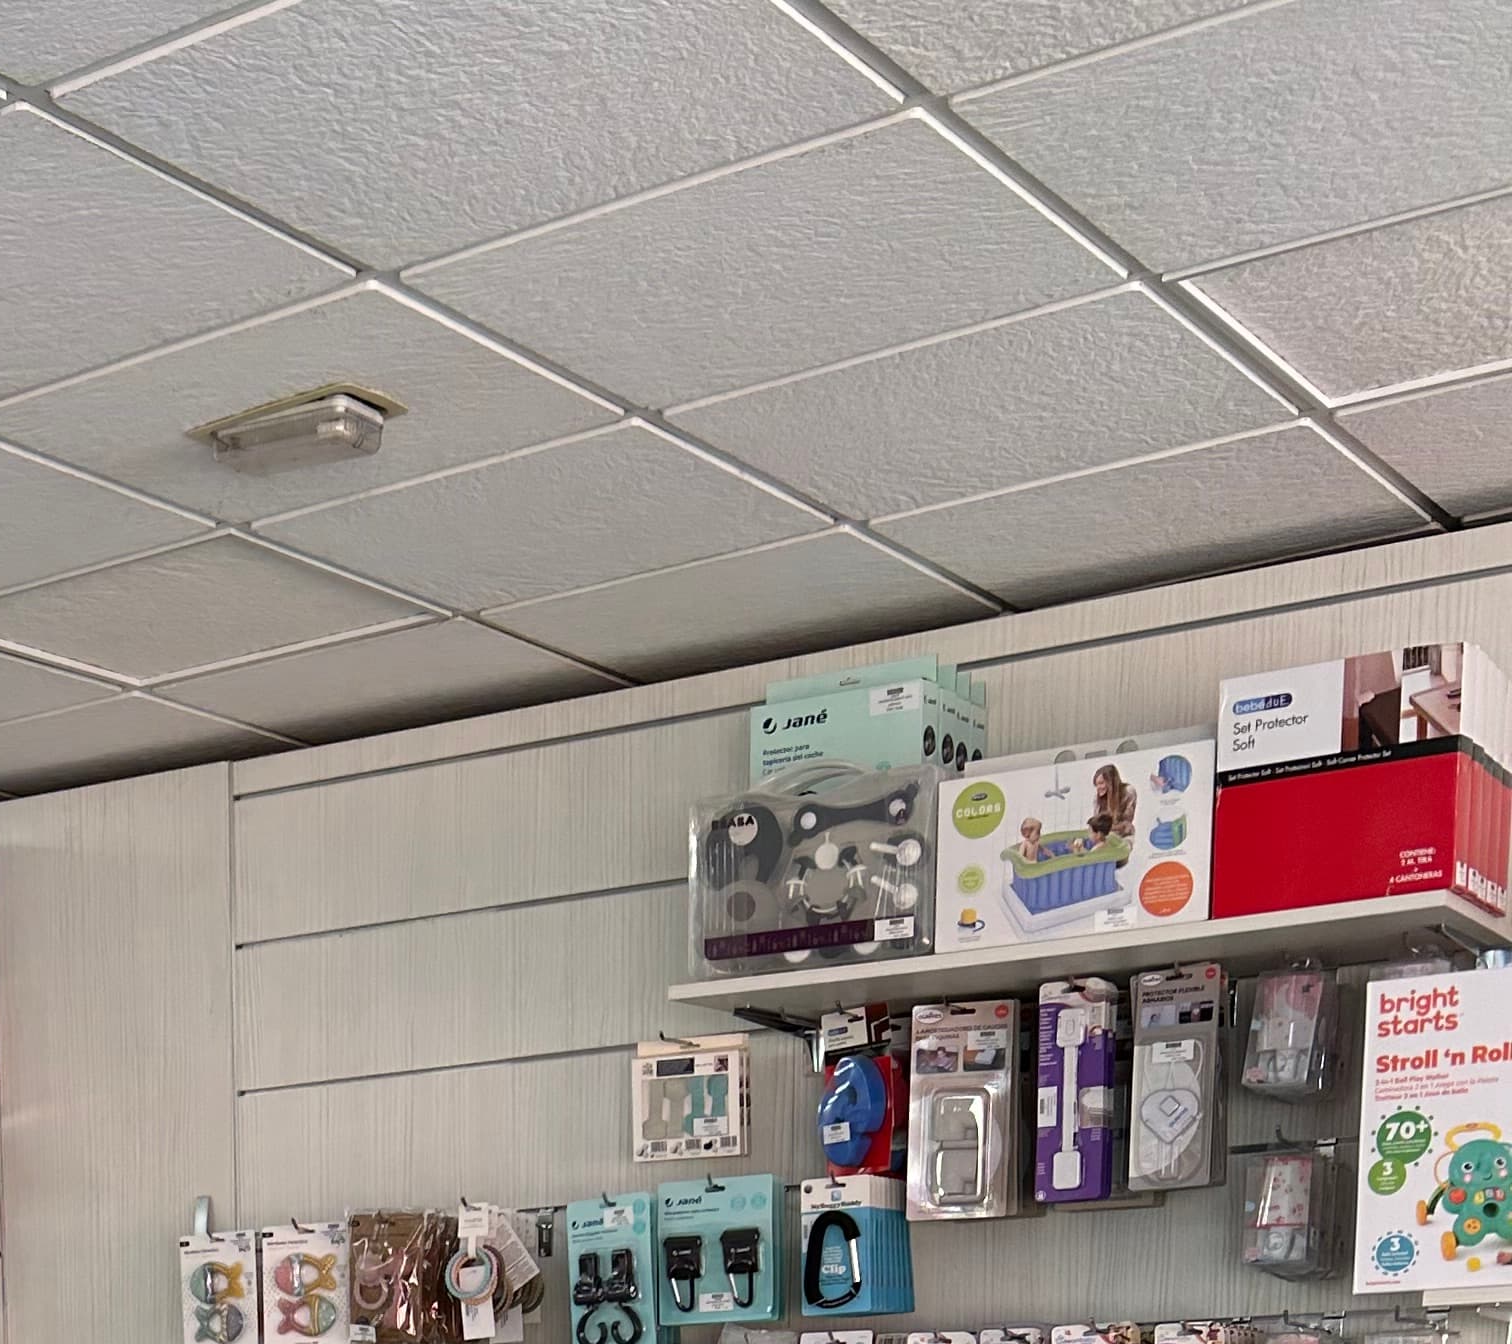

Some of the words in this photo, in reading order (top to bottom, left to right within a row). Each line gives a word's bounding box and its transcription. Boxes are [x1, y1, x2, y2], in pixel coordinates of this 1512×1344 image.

[1233, 720, 1251, 735] Set
[1254, 713, 1309, 732] Protector
[1232, 735, 1256, 752] Soft
[1379, 985, 1459, 1016] bright
[1377, 1011, 1459, 1038] starts
[1376, 1049, 1438, 1073] Stroll
[1385, 1119, 1429, 1141] 70+
[1382, 1161, 1393, 1176] 3
[1390, 1237, 1401, 1251] 3
[821, 1263, 847, 1275] Clip
